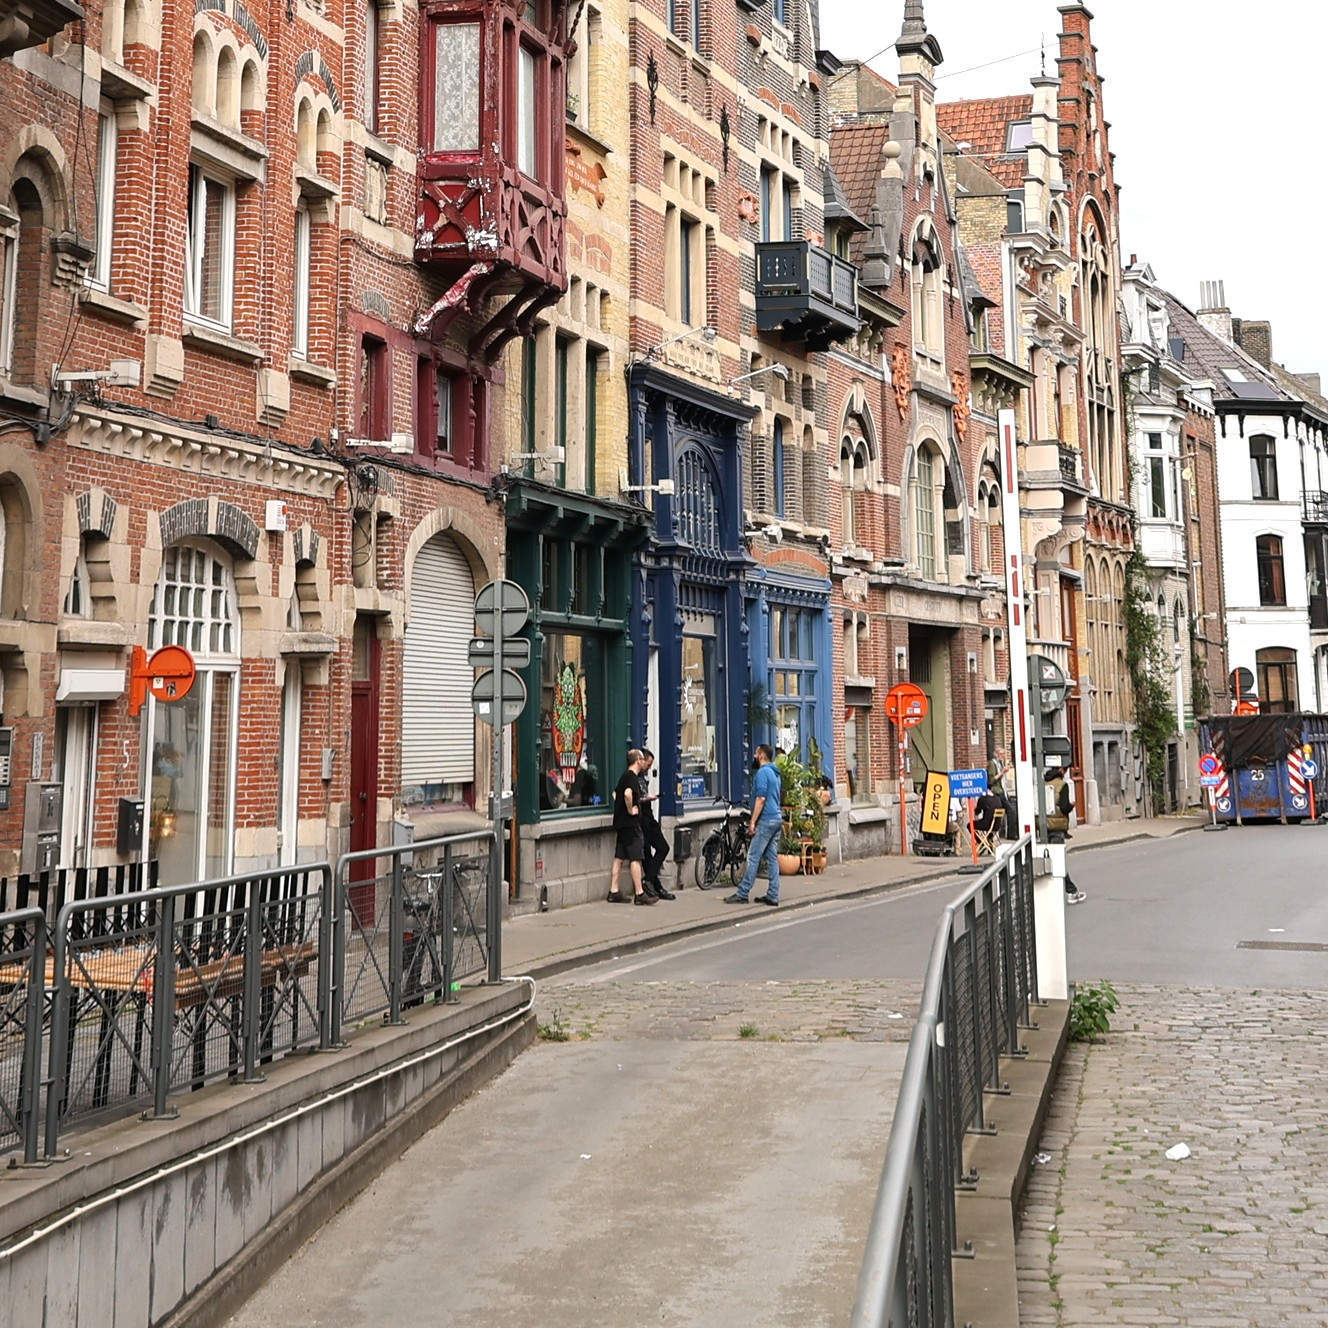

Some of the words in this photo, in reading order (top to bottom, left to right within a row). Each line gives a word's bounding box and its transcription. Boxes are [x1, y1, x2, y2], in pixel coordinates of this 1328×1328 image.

[122, 740, 130, 769] 5
[950, 771, 984, 781] VOETGANGERS
[1251, 769, 1265, 781] 25
[931, 783, 943, 821] OPEN
